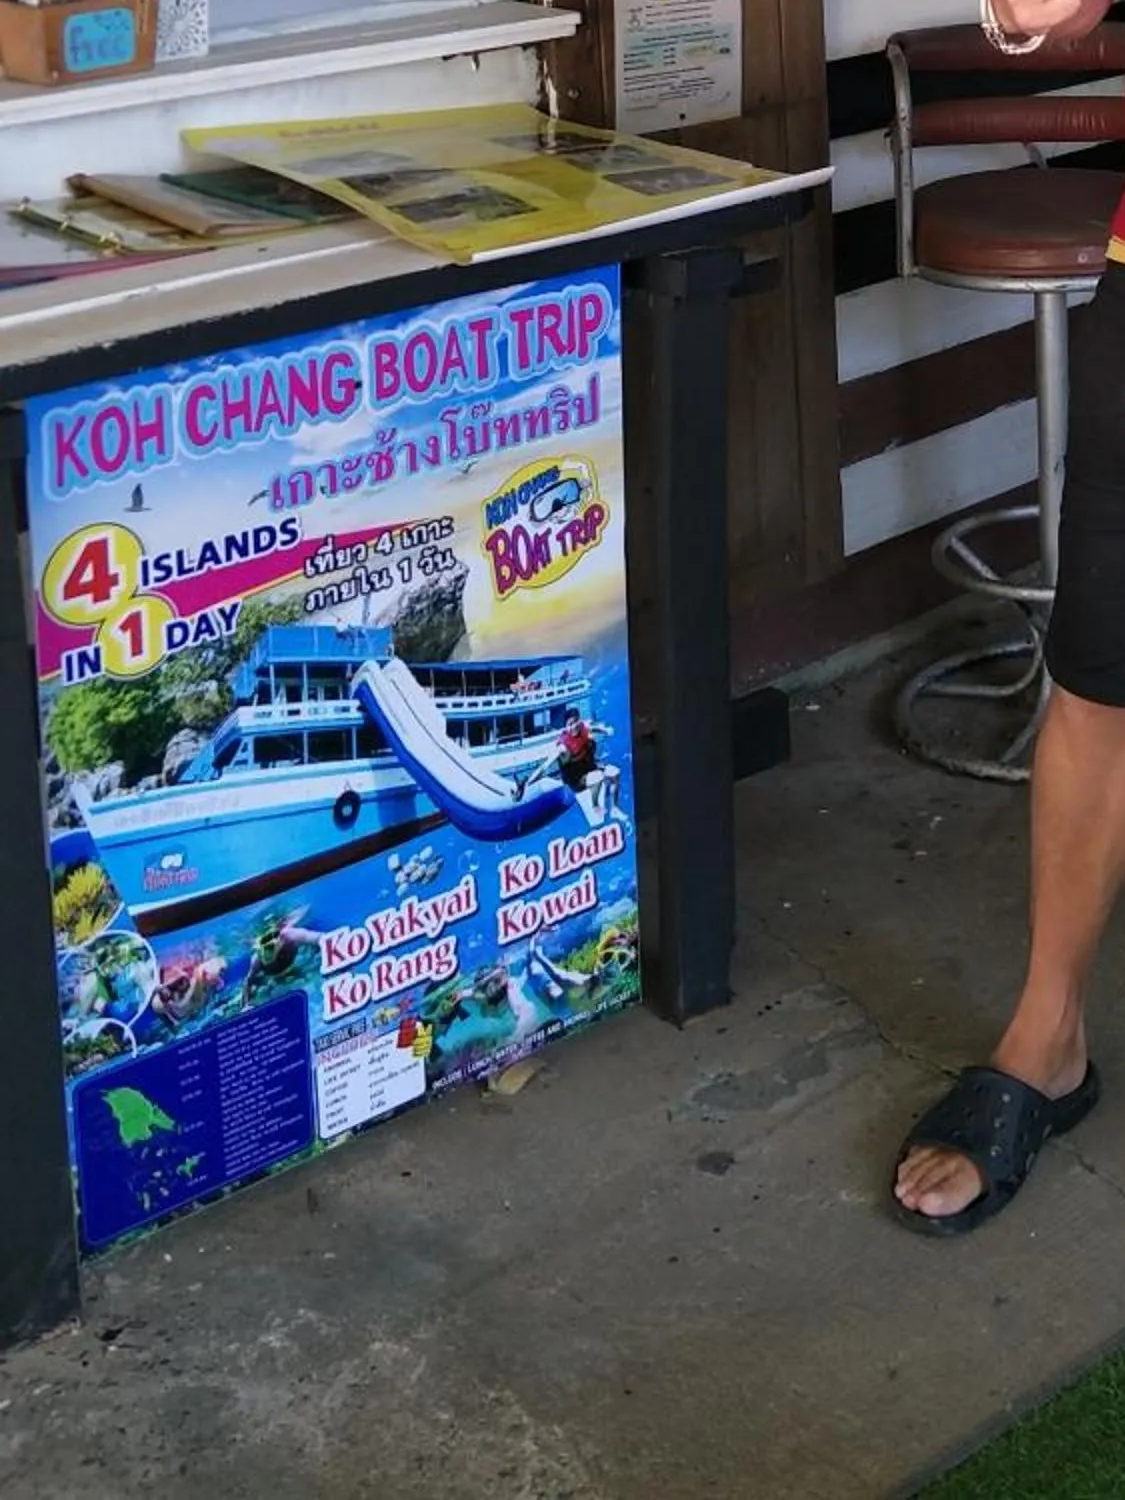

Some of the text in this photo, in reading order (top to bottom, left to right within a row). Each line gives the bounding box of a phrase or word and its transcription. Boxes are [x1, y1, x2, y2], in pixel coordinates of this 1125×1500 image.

[55, 292, 604, 488] KOH CHANG BOAT TRIP
[269, 373, 601, 508] เกาะช้างโบ๊ททริป
[62, 517, 299, 604] 4 ISLANDS
[304, 516, 455, 578] เที่ยว 4 เกาะ
[305, 544, 457, 612] ภายใน 1 วัน
[485, 502, 606, 596] BOAT TRIP
[65, 602, 240, 682] IN 1 DAY
[502, 825, 621, 895] Ko Loan
[323, 877, 475, 970] Ko Yakyai
[500, 904, 538, 941] Ko
[325, 940, 455, 1017] Ko Rang
